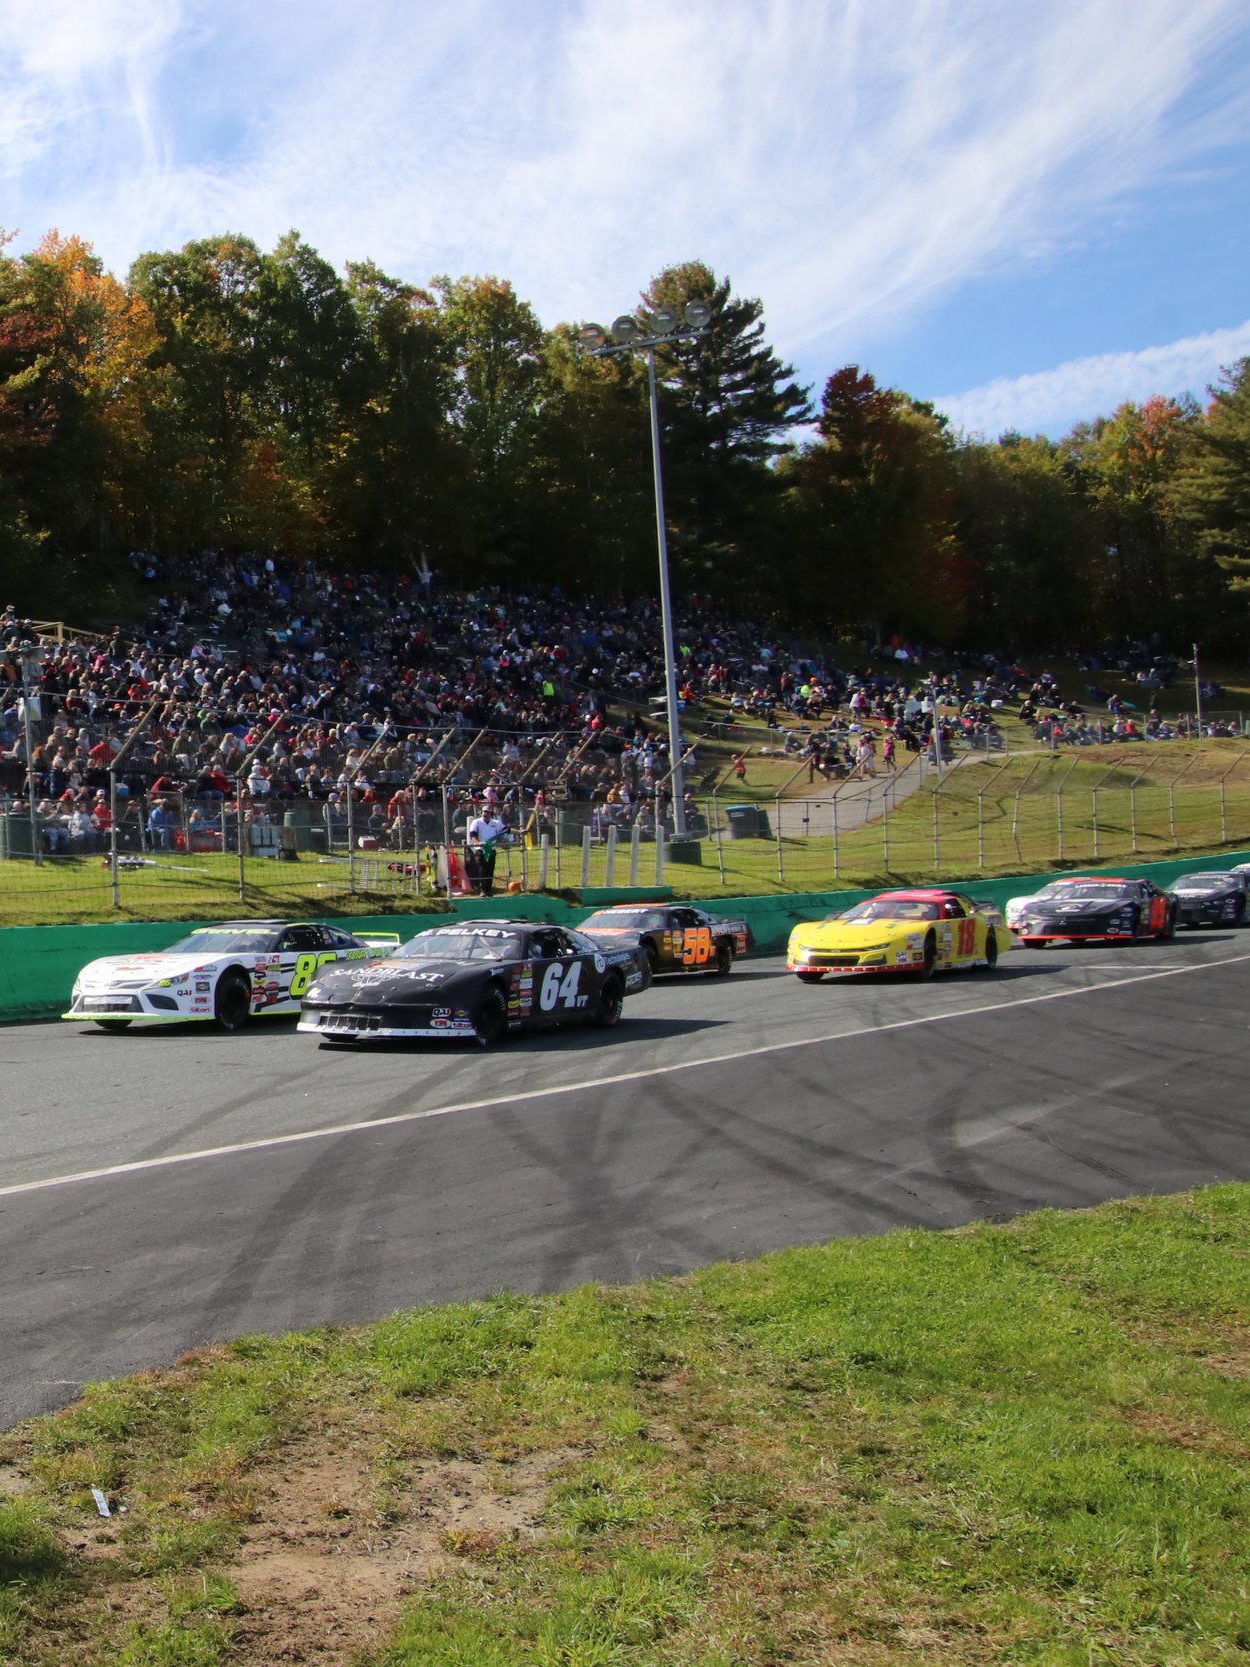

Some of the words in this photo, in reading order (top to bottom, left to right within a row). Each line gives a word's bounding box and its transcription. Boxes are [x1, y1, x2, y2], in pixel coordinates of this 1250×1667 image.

[435, 928, 517, 938] PELKEY
[683, 927, 710, 965] 58
[329, 967, 445, 983] SANDBLAST
[540, 961, 582, 1011] 64
[577, 995, 589, 1007] VT
